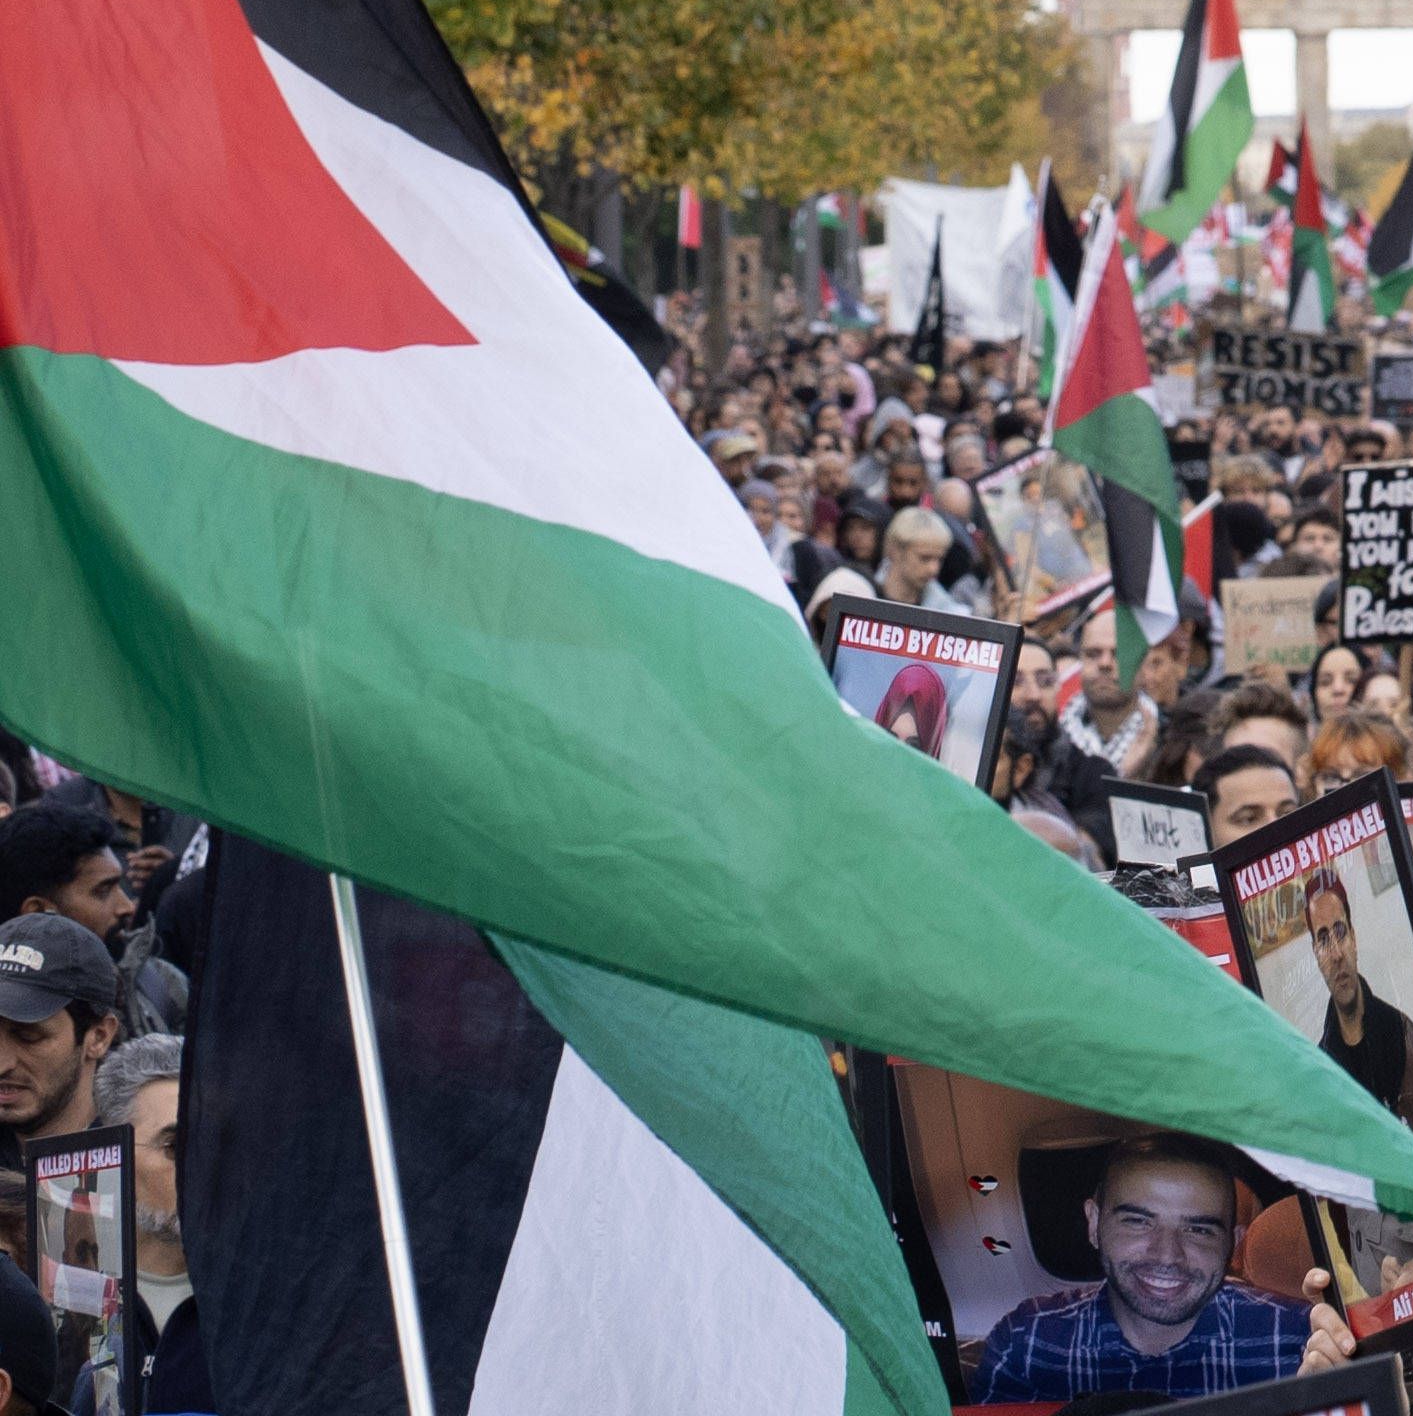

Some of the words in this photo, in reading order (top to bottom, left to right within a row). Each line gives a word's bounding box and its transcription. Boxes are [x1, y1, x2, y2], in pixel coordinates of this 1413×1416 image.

[1214, 330, 1359, 377] RESIST
[1345, 471, 1368, 509] I
[841, 618, 904, 650] KILLED
[907, 629, 937, 657] BY
[935, 634, 1001, 669] ISRAEL
[1235, 848, 1295, 901] KILLED
[1297, 835, 1323, 867] BY
[1324, 801, 1386, 858] ISRAEL
[38, 1153, 71, 1177] KILLED
[72, 1151, 86, 1172] BY
[1393, 1292, 1412, 1322] Ali
